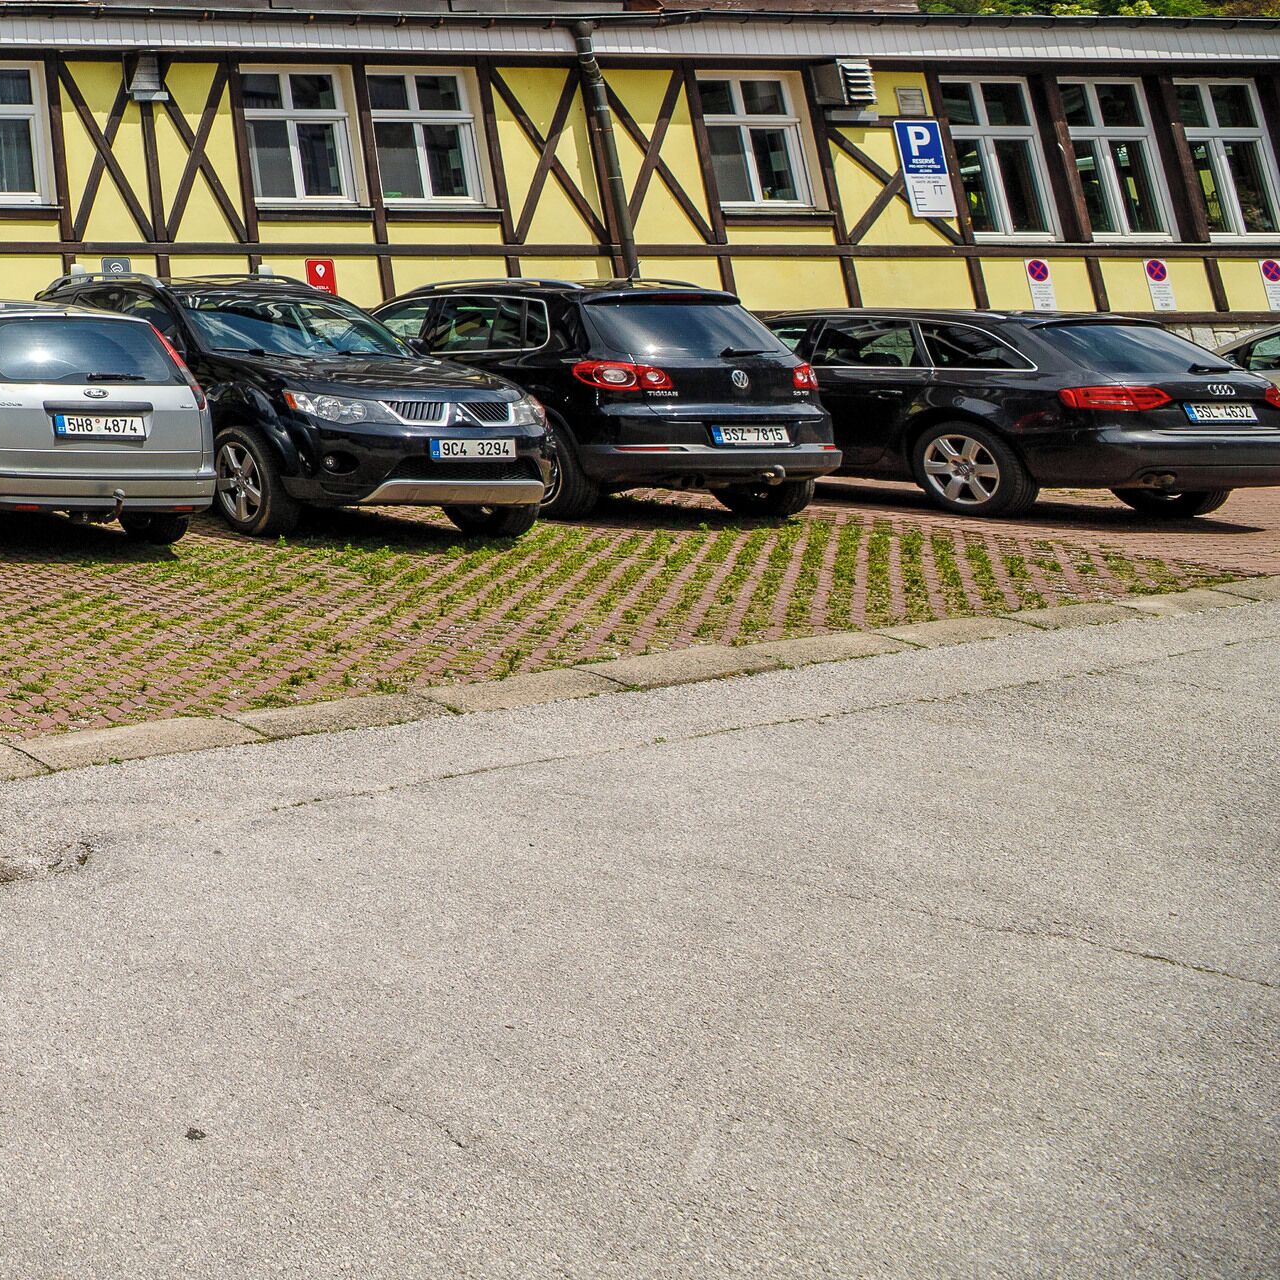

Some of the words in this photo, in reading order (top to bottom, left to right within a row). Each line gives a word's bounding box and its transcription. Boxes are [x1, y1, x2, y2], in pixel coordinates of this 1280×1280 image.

[906, 126, 931, 157] P
[1194, 405, 1218, 418] 5SL
[1223, 405, 1251, 418] 4632
[67, 418, 93, 432] 5H8
[104, 420, 137, 433] 4874
[723, 428, 747, 441] 5SZ
[755, 428, 783, 441] 7815
[442, 442, 467, 456] 9C4
[478, 442, 509, 456] 3294
